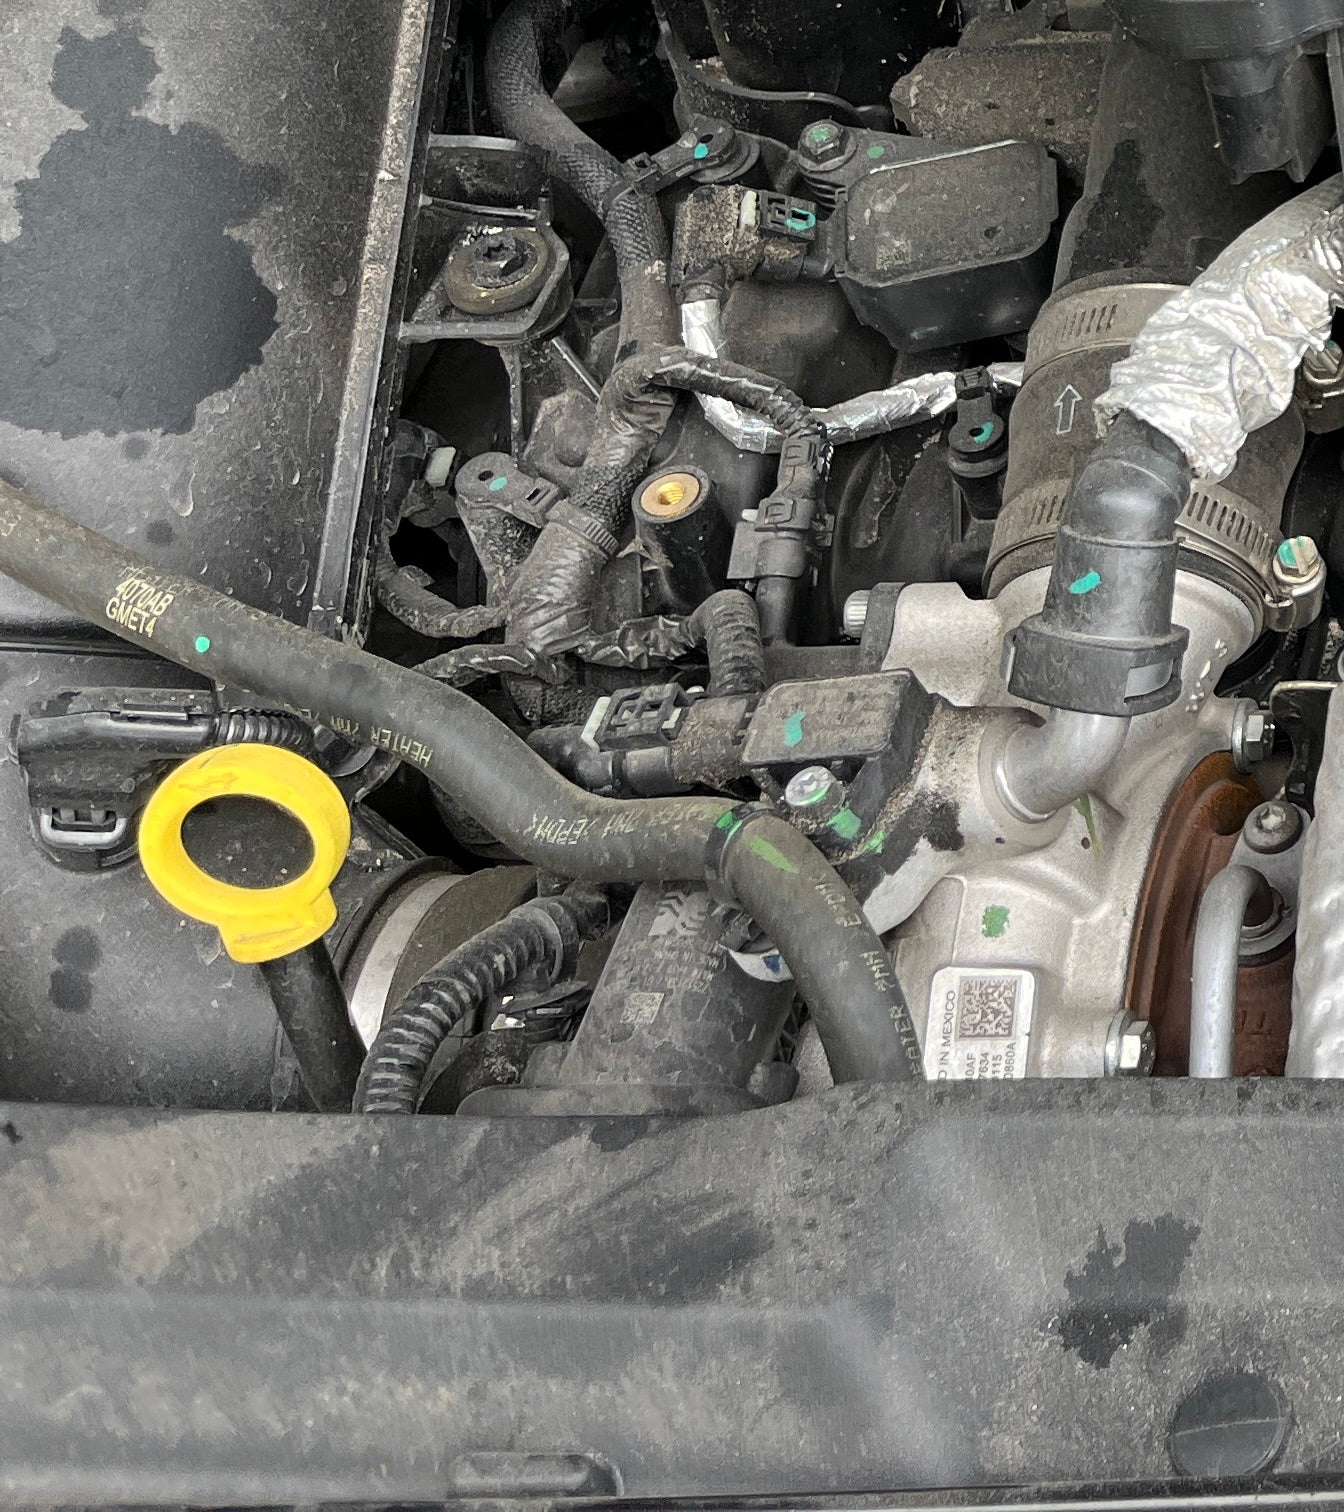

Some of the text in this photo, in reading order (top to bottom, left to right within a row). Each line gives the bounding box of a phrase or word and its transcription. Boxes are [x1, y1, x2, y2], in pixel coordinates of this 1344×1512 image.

[115, 578, 175, 615] 4070AB
[105, 597, 157, 638] GMET4
[370, 724, 435, 768] HEATER
[941, 991, 957, 1047] MEXICO
[939, 1052, 950, 1066] IN
